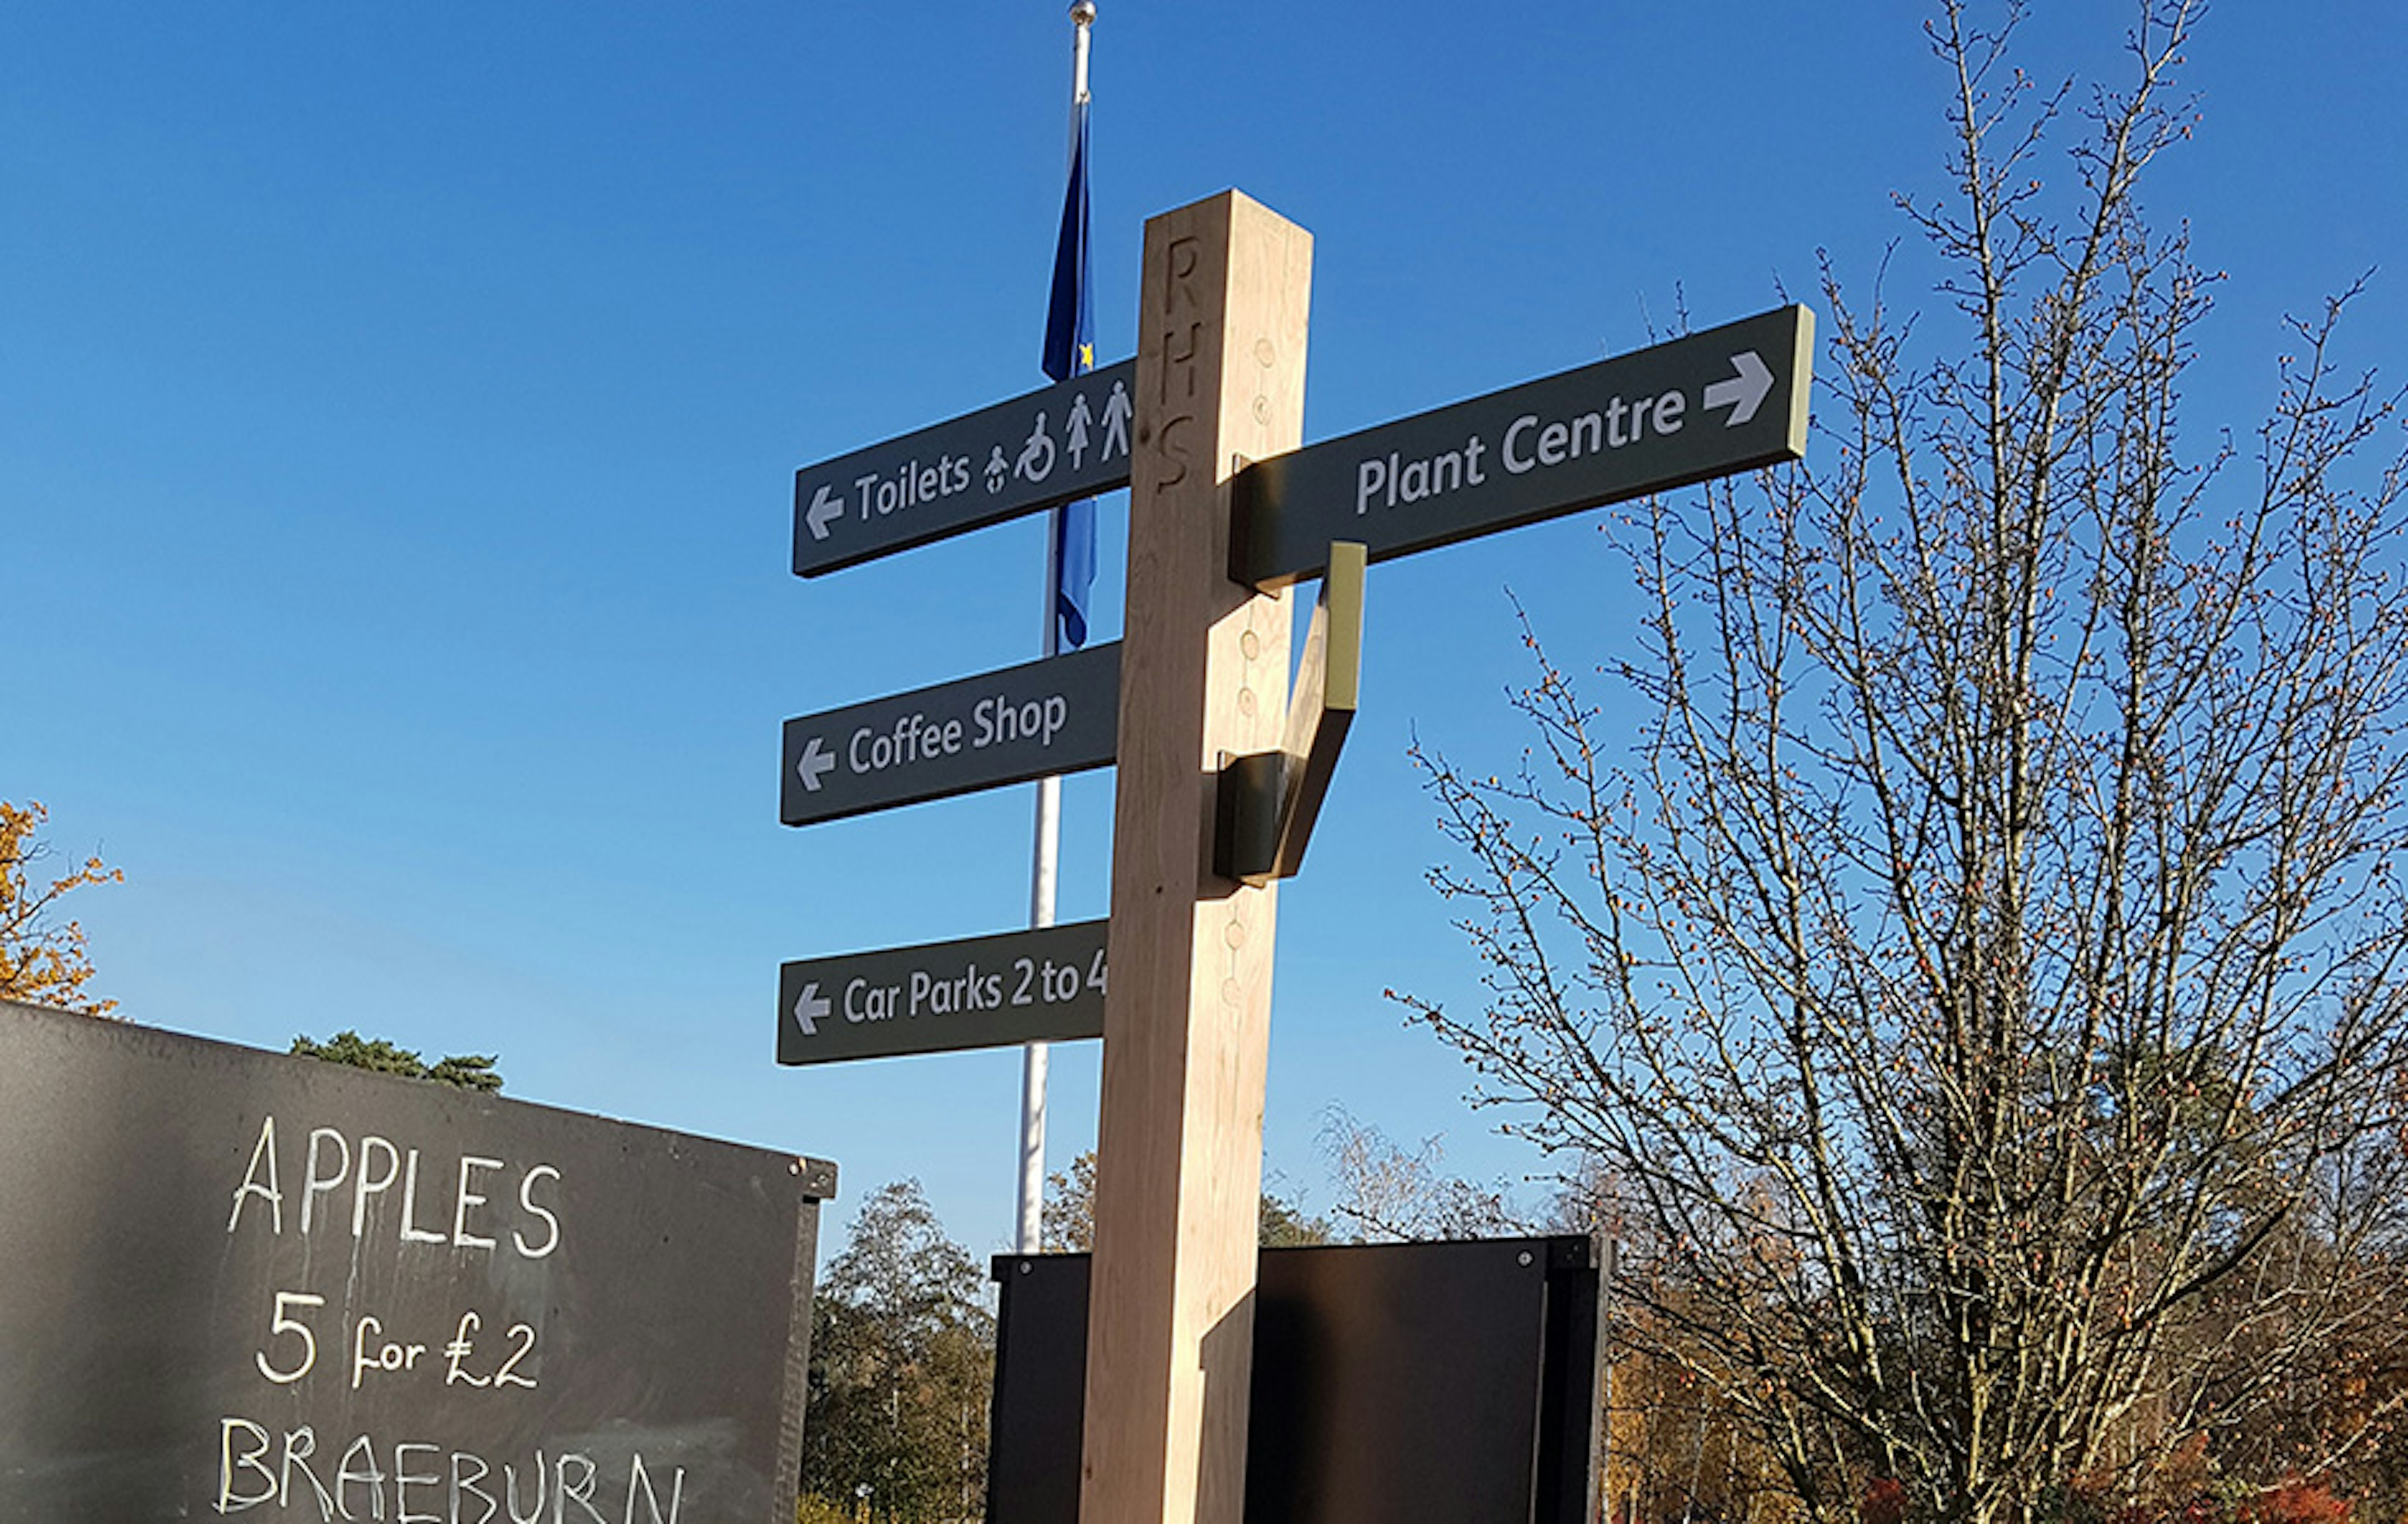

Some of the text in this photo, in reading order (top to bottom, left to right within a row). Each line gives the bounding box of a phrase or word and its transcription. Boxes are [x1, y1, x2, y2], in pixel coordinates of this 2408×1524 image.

[1157, 235, 1202, 494] RHS
[854, 453, 971, 521] Toilets
[1355, 388, 1687, 516] Plant Centre
[848, 692, 1067, 775] Coffee Shop
[843, 947, 1107, 1025] Car Parks 2 to 4
[228, 1116, 561, 1259] APPLES
[255, 1291, 539, 1389] 5 for £2
[213, 1416, 687, 1524] BRAEBURN
